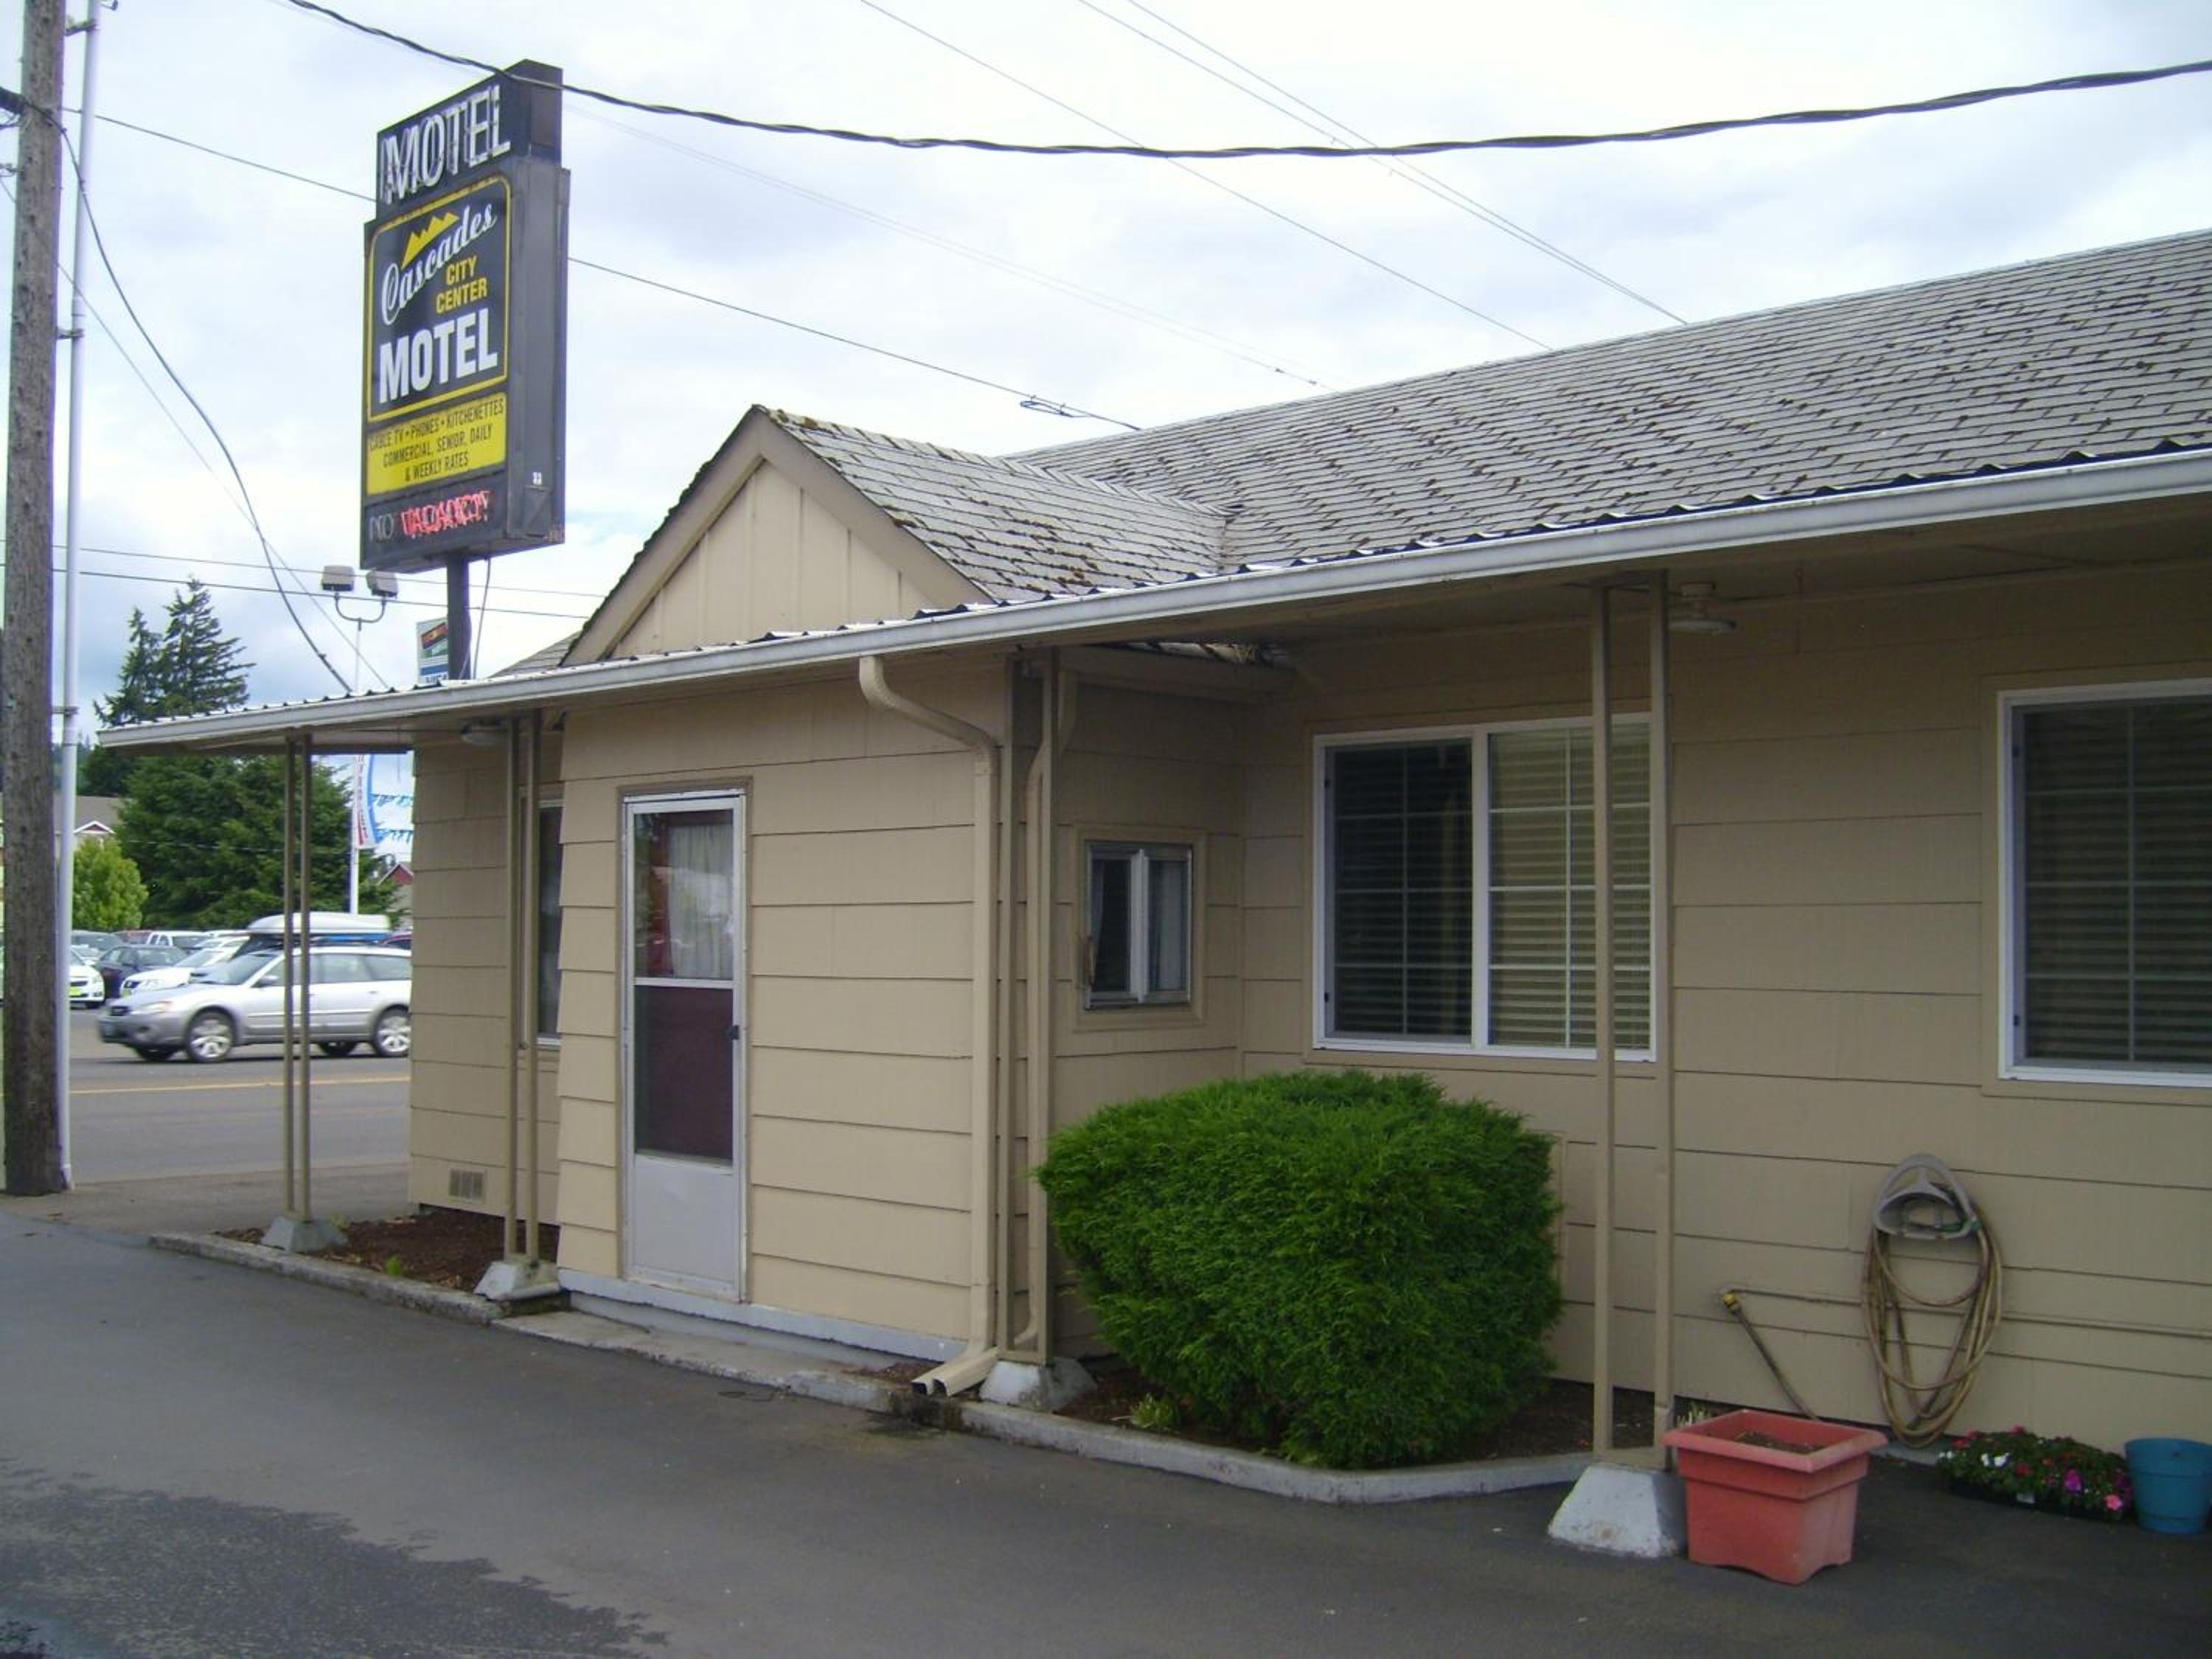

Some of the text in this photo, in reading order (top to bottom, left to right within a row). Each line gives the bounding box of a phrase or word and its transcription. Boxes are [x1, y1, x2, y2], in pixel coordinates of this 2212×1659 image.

[380, 84, 511, 206] MOTEL
[381, 204, 498, 326] Cascades
[446, 256, 478, 285] CITY
[436, 277, 488, 314] CENTER
[378, 307, 498, 404] MOTEL
[447, 398, 504, 429] KITCHENETTES
[470, 423, 493, 444] DAILY
[413, 458, 442, 479] WEEKLY
[445, 451, 469, 470] RATES
[370, 490, 490, 543] NO VACANCY
